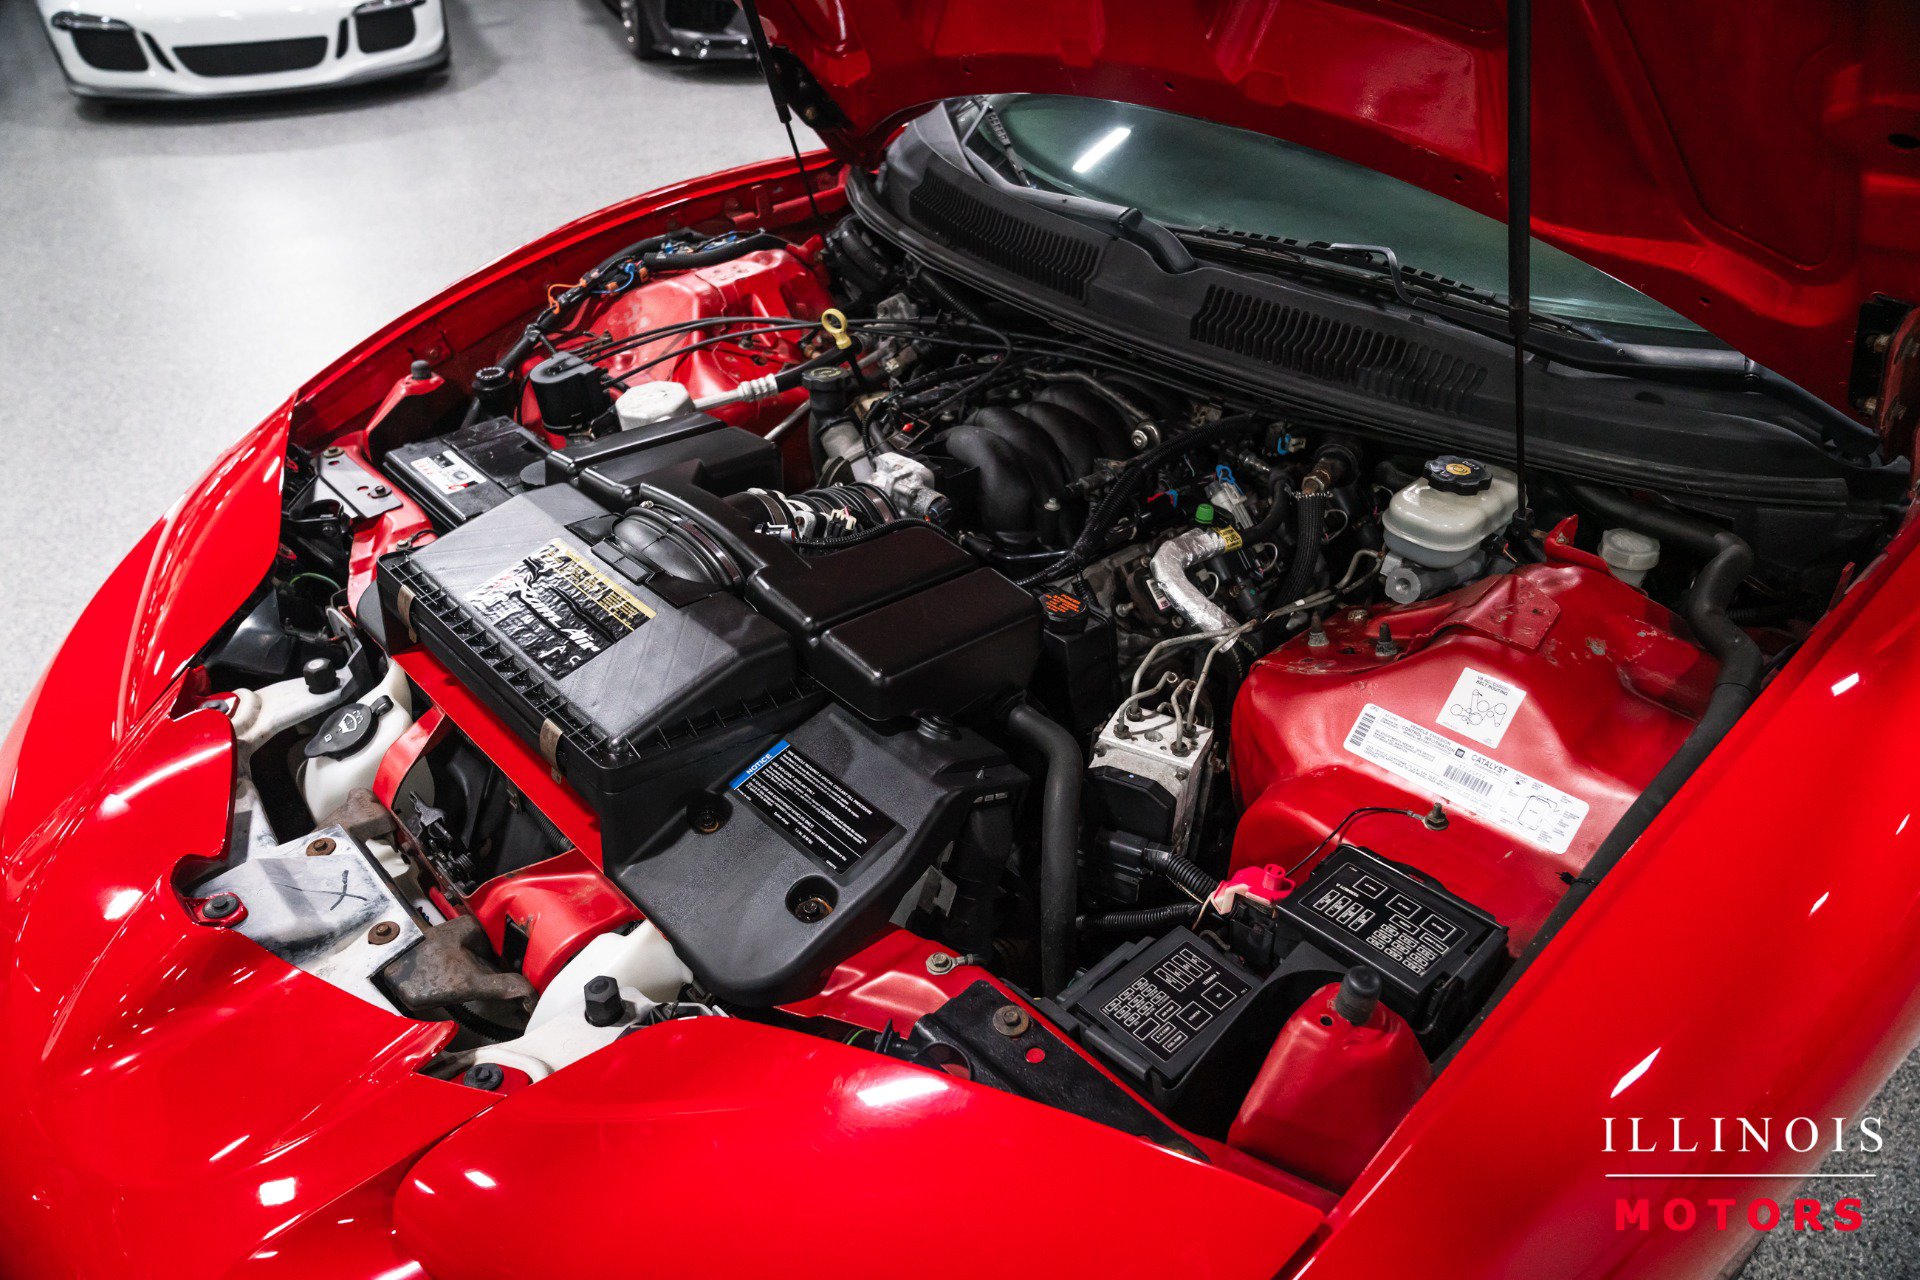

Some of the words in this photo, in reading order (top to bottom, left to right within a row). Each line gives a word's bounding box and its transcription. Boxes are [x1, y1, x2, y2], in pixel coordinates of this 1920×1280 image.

[560, 627, 601, 653] Air
[1488, 685, 1508, 696] ROUTING
[1402, 726, 1422, 738] CONTROL
[1425, 736, 1455, 752] INFORMATION
[1410, 724, 1428, 735] VEHICLE
[1429, 733, 1451, 746] EMISSION
[746, 753, 772, 774] NOTICE
[1472, 755, 1508, 774] CATALYST
[793, 778, 808, 789] COOLANT
[794, 755, 805, 765] VEHICLE
[805, 763, 819, 775] REQUIRES
[821, 776, 833, 786] SPECIAL
[833, 785, 848, 796] COOLANT
[853, 800, 872, 815] PROCEDURE
